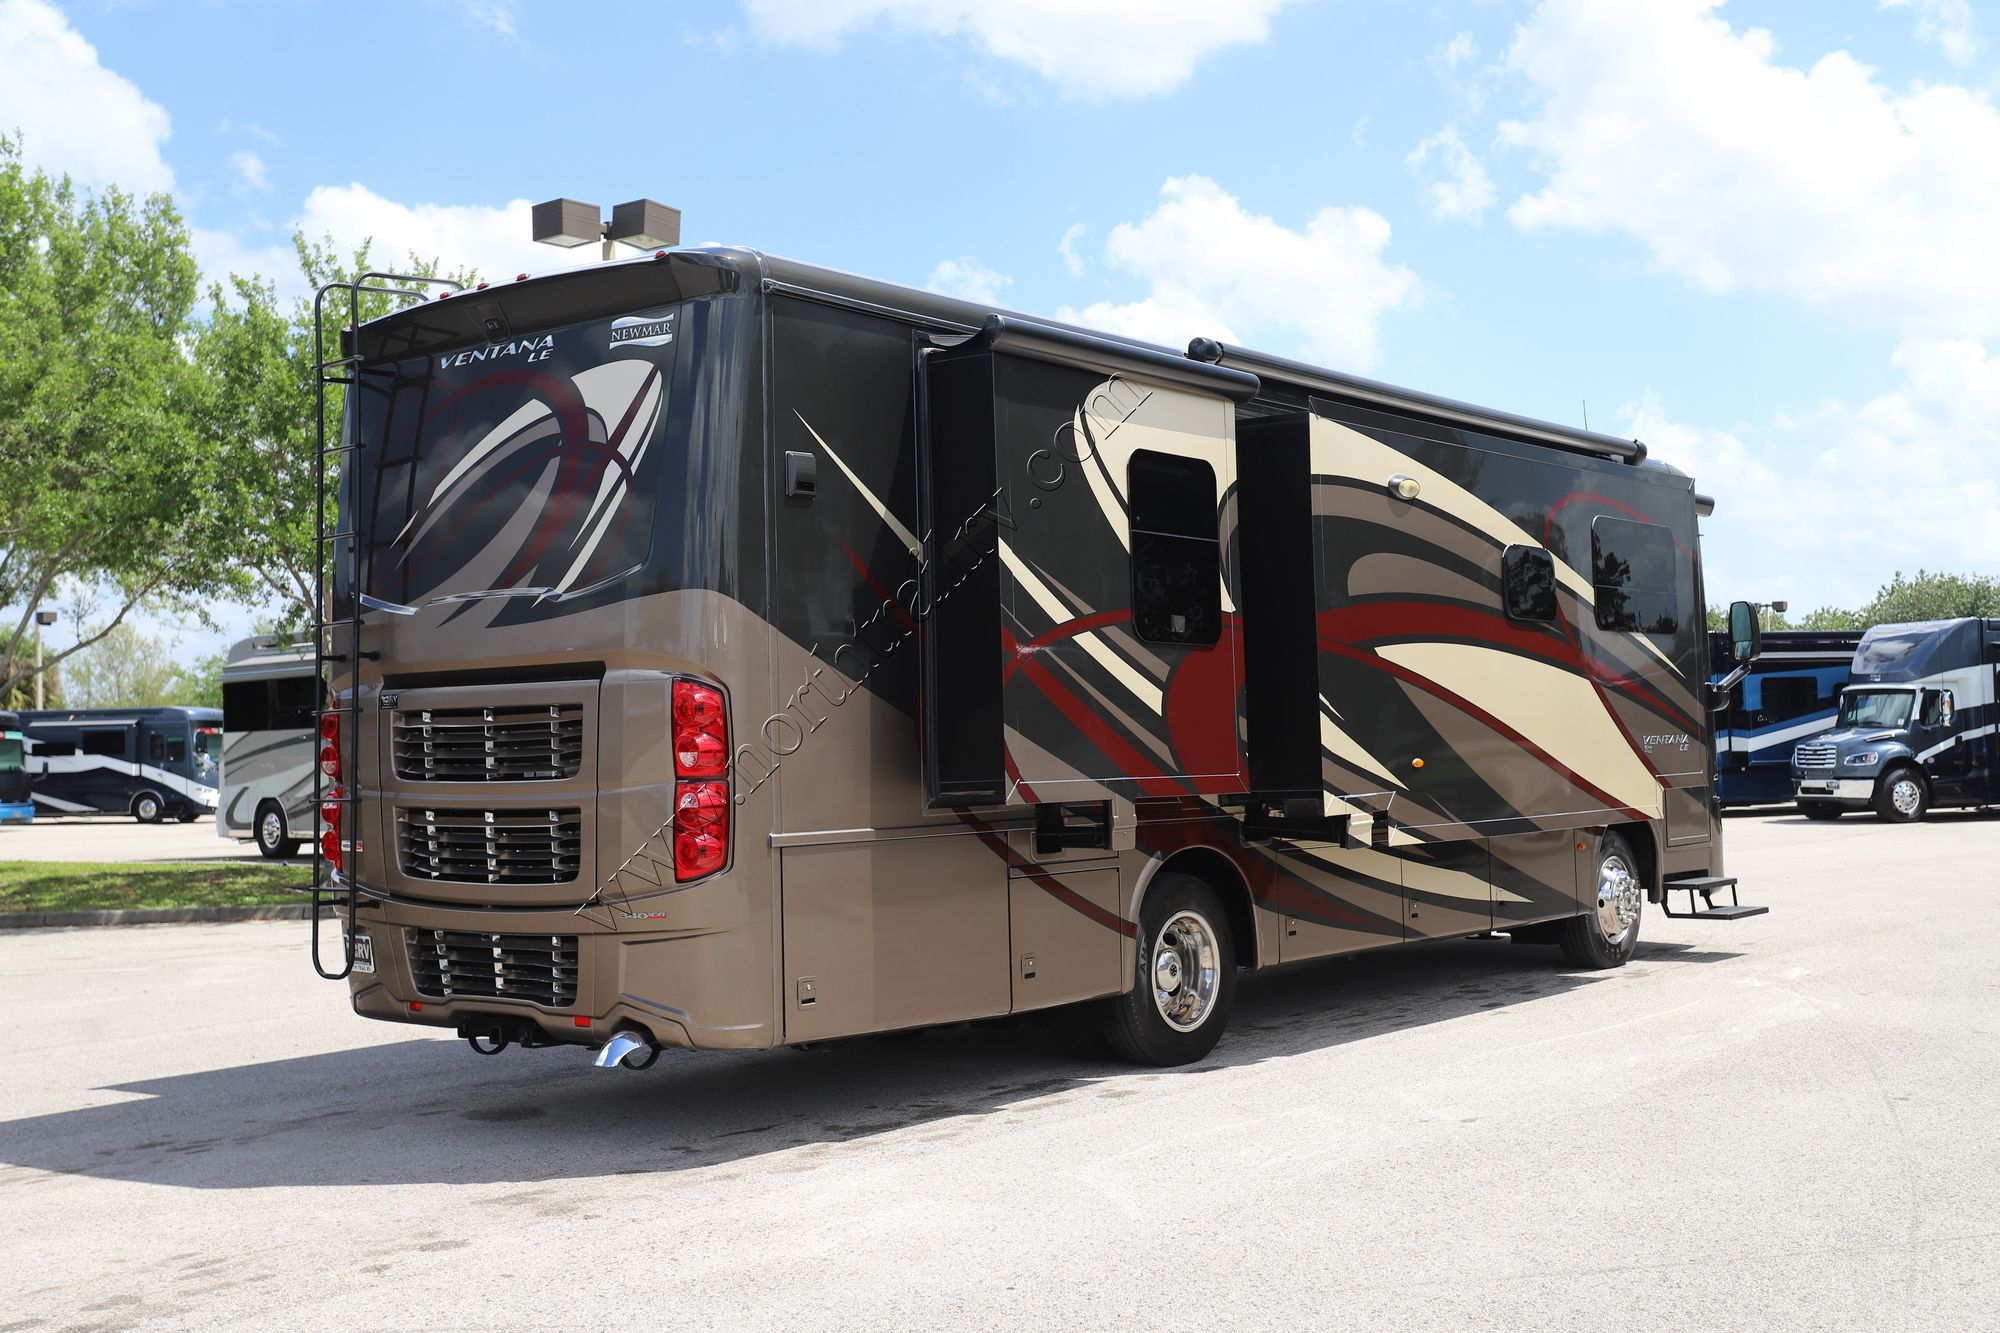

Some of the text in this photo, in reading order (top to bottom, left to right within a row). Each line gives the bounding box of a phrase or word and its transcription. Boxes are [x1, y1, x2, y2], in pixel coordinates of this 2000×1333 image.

[610, 322, 672, 342] NEWMAR
[439, 334, 555, 370] VENTANA
[527, 348, 553, 363] LE
[1643, 734, 1689, 744] VENTANA
